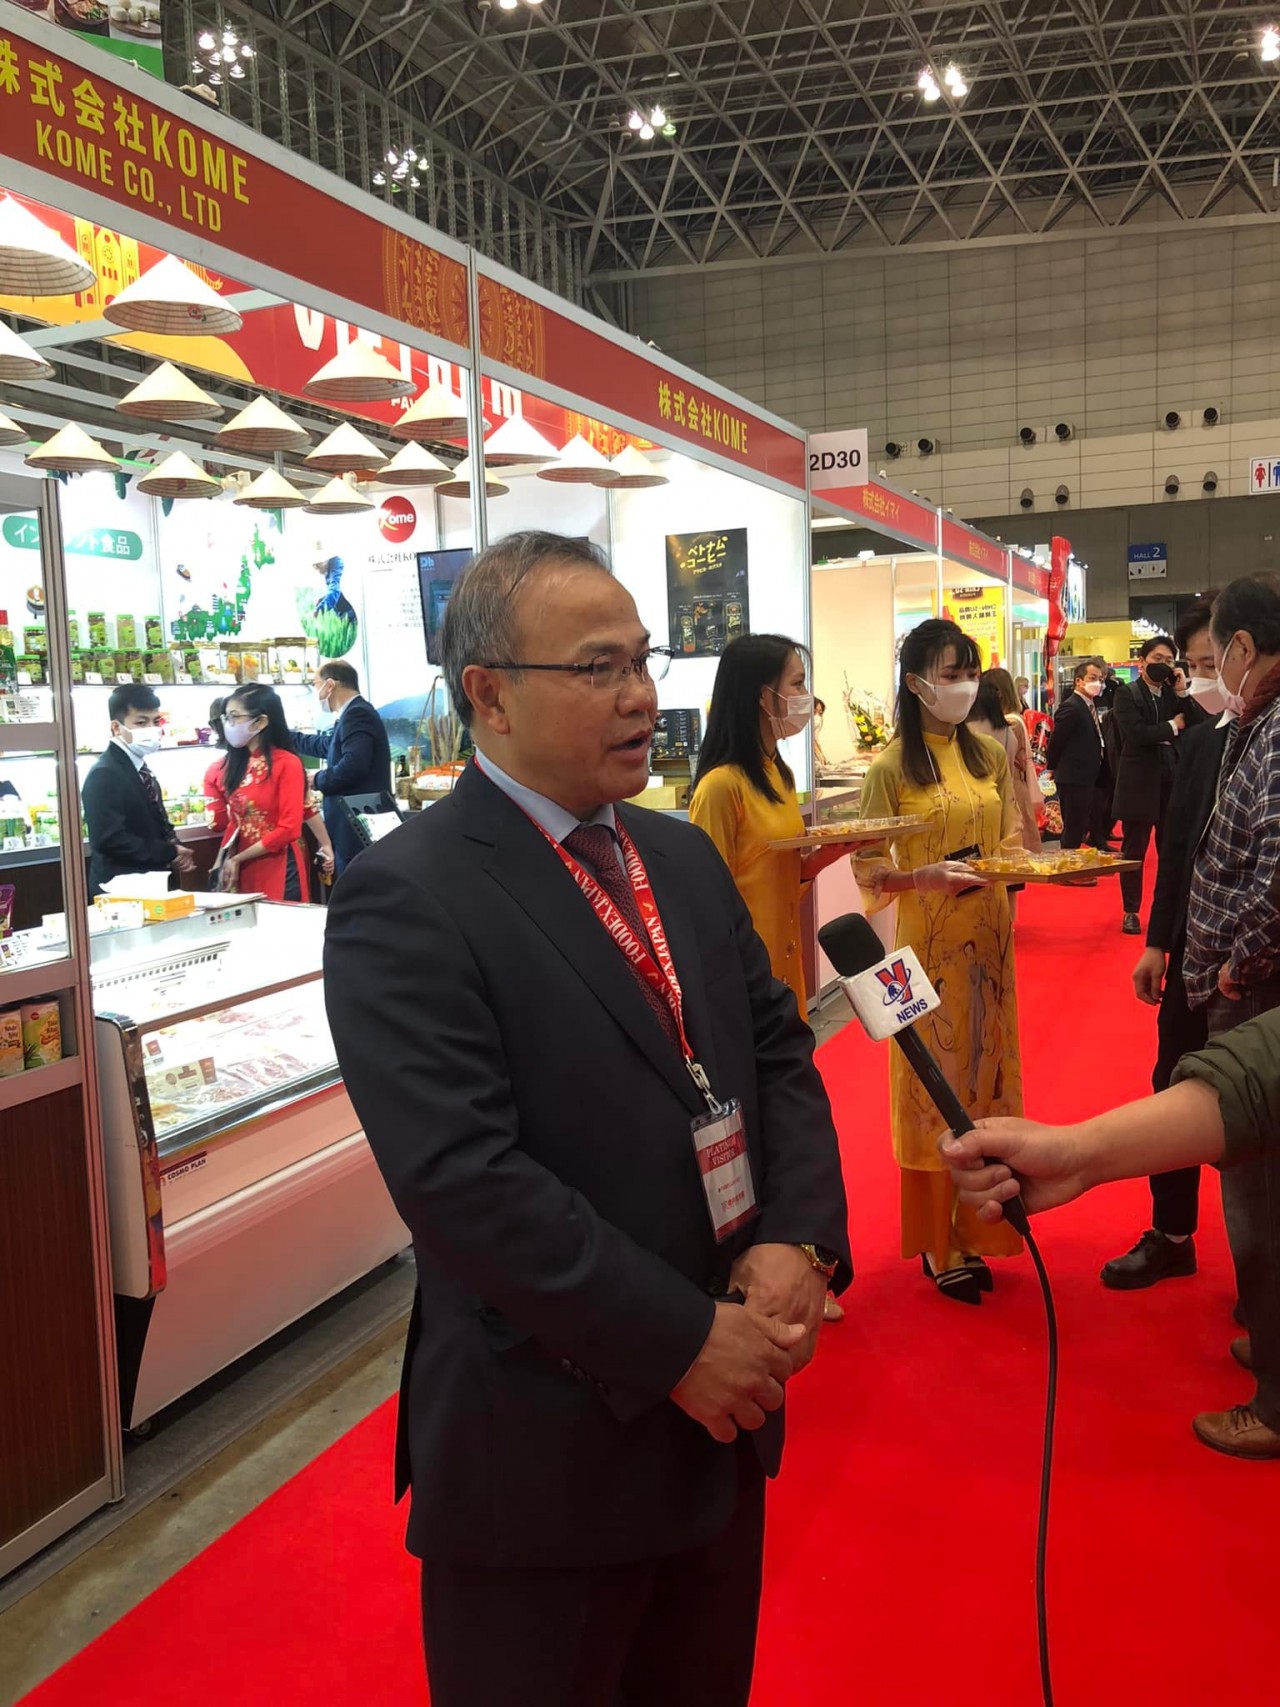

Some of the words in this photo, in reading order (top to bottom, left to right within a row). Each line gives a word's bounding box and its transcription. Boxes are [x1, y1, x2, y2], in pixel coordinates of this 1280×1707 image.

[0, 39, 249, 204] 株式会社KOME
[36, 119, 114, 186] KOME
[123, 160, 172, 215] CO.,
[180, 185, 221, 232] LTD
[658, 380, 748, 454] 株式会社KOME
[810, 449, 861, 471] 2D30
[686, 551, 727, 569] コーヒー
[687, 539, 726, 556] ベトナム
[1152, 547, 1160, 558] 2
[573, 869, 610, 909] JAPAN
[601, 904, 647, 965] FOODEX
[645, 916, 671, 960] JAPAN
[896, 998, 928, 1023] NEWS
[167, 1166, 189, 1180] COSMO
[191, 1159, 206, 1169] PLAN
